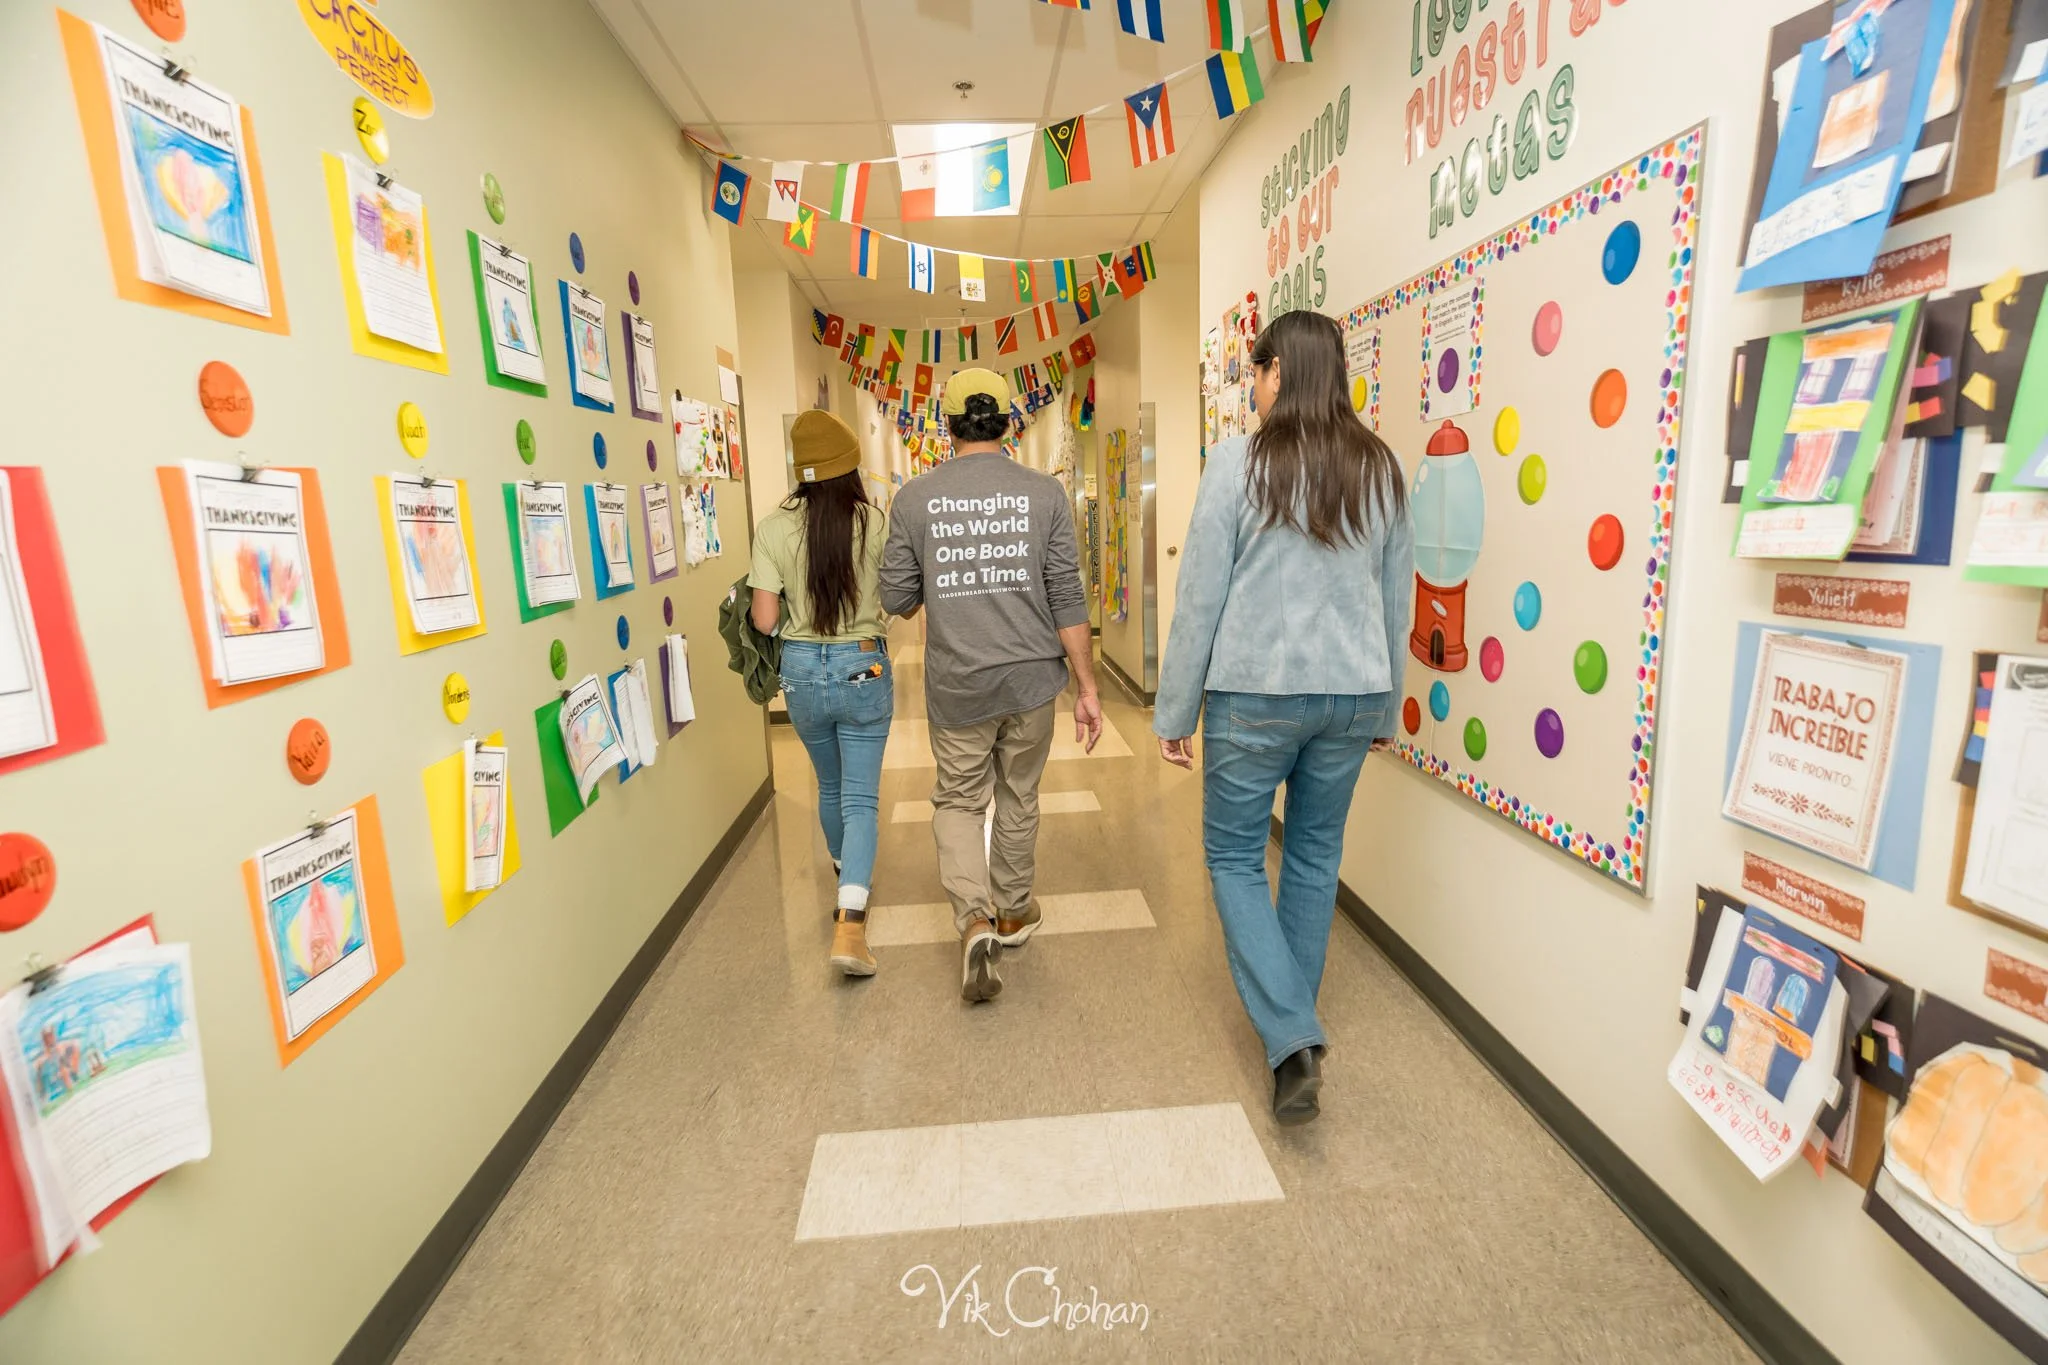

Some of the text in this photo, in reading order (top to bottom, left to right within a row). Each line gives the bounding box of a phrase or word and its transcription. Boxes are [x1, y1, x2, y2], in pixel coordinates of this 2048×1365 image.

[310, 0, 418, 85] CACTUS
[352, 37, 398, 83] MAKES
[336, 46, 409, 110] PERFECT
[121, 76, 234, 148] THANKSGIVING
[1268, 165, 1338, 277] to our
[485, 260, 526, 290] THANKSGIVING
[206, 506, 297, 528] THANKSGIVING
[398, 504, 455, 518] THANKSGIVING
[927, 492, 1030, 516] Changing
[930, 515, 1030, 539] the World
[935, 540, 1030, 563] One Book
[936, 565, 1031, 588] at a Time.
[1808, 587, 1857, 608] Yuliett
[1774, 675, 1876, 725] TRABAJO
[1767, 750, 1798, 773] VIENE
[270, 841, 352, 894] THANKSGIVING
[1775, 876, 1826, 912] Marwin
